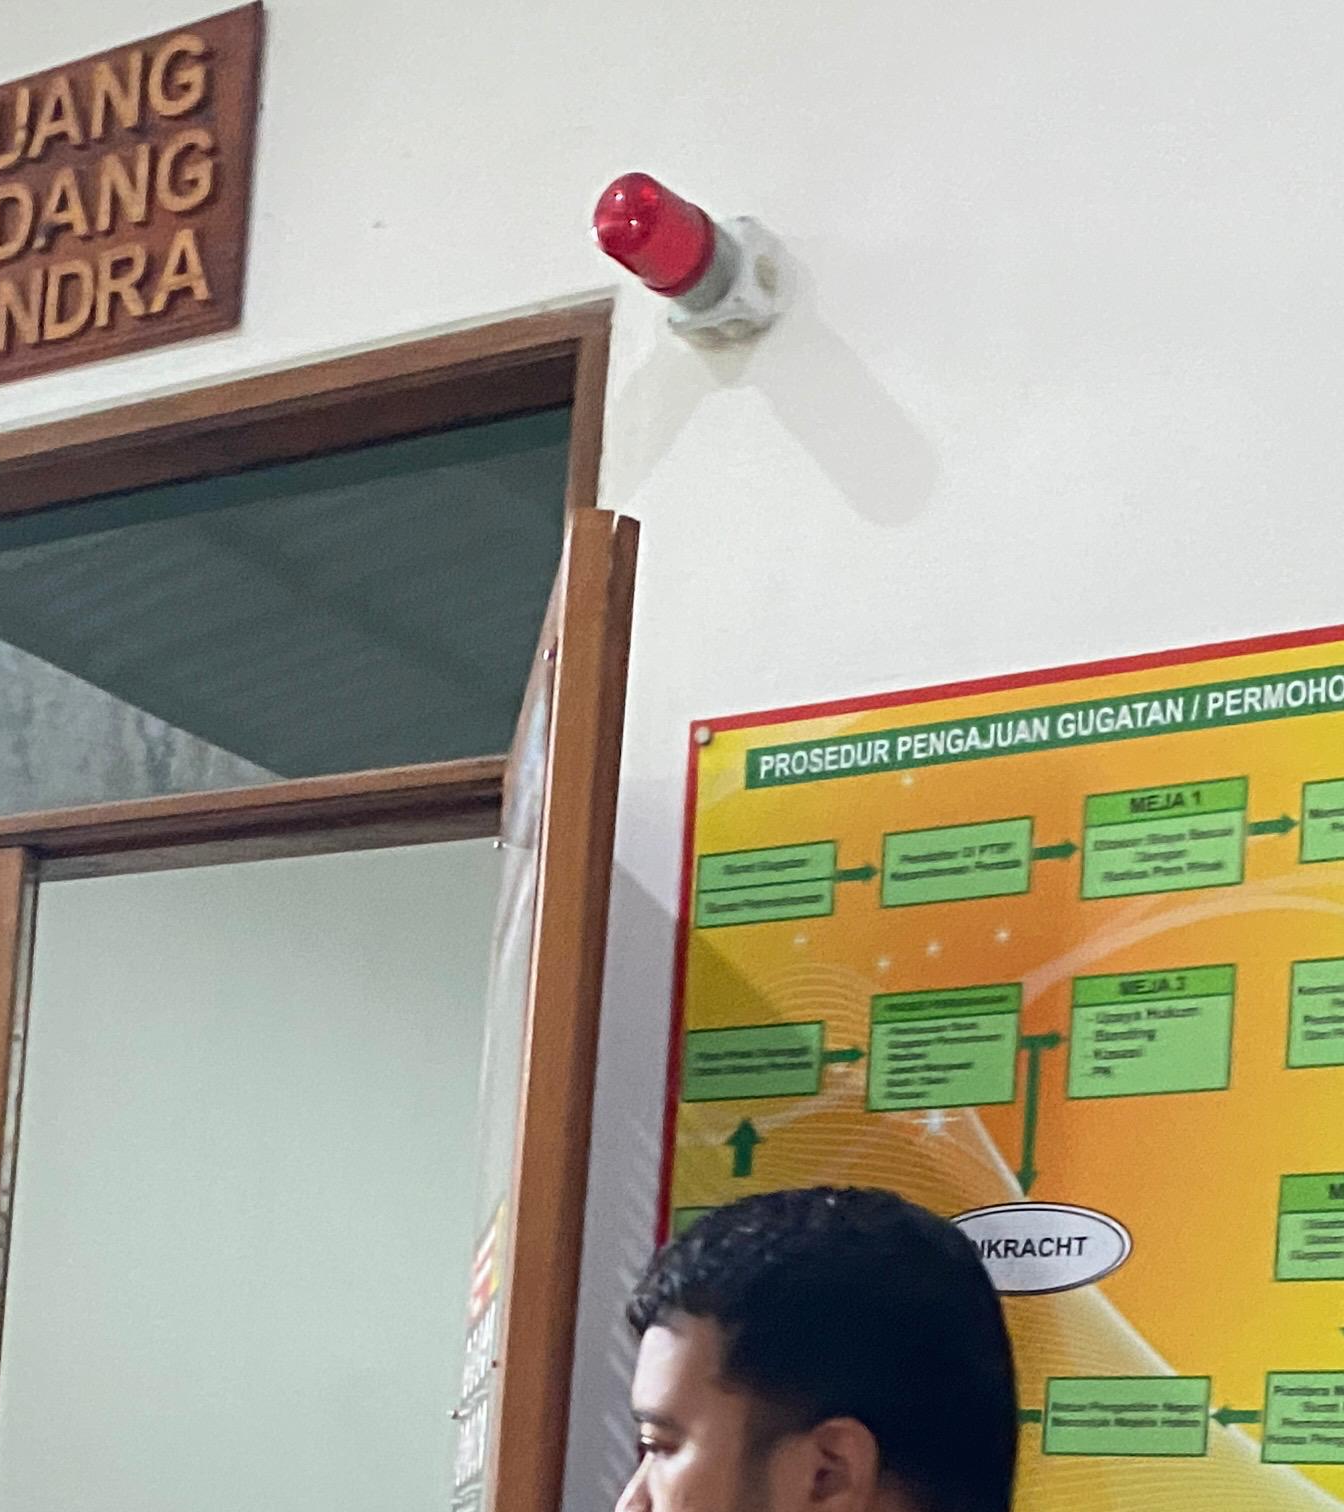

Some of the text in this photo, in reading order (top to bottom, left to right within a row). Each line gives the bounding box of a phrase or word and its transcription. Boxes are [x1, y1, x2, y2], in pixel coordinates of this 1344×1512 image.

[759, 739, 890, 780] PROSEDUR
[897, 716, 1050, 761] PENGAJUAN
[1057, 696, 1184, 739] GUGATAN
[1189, 693, 1199, 721] /
[1129, 790, 1201, 814] MEJA 1
